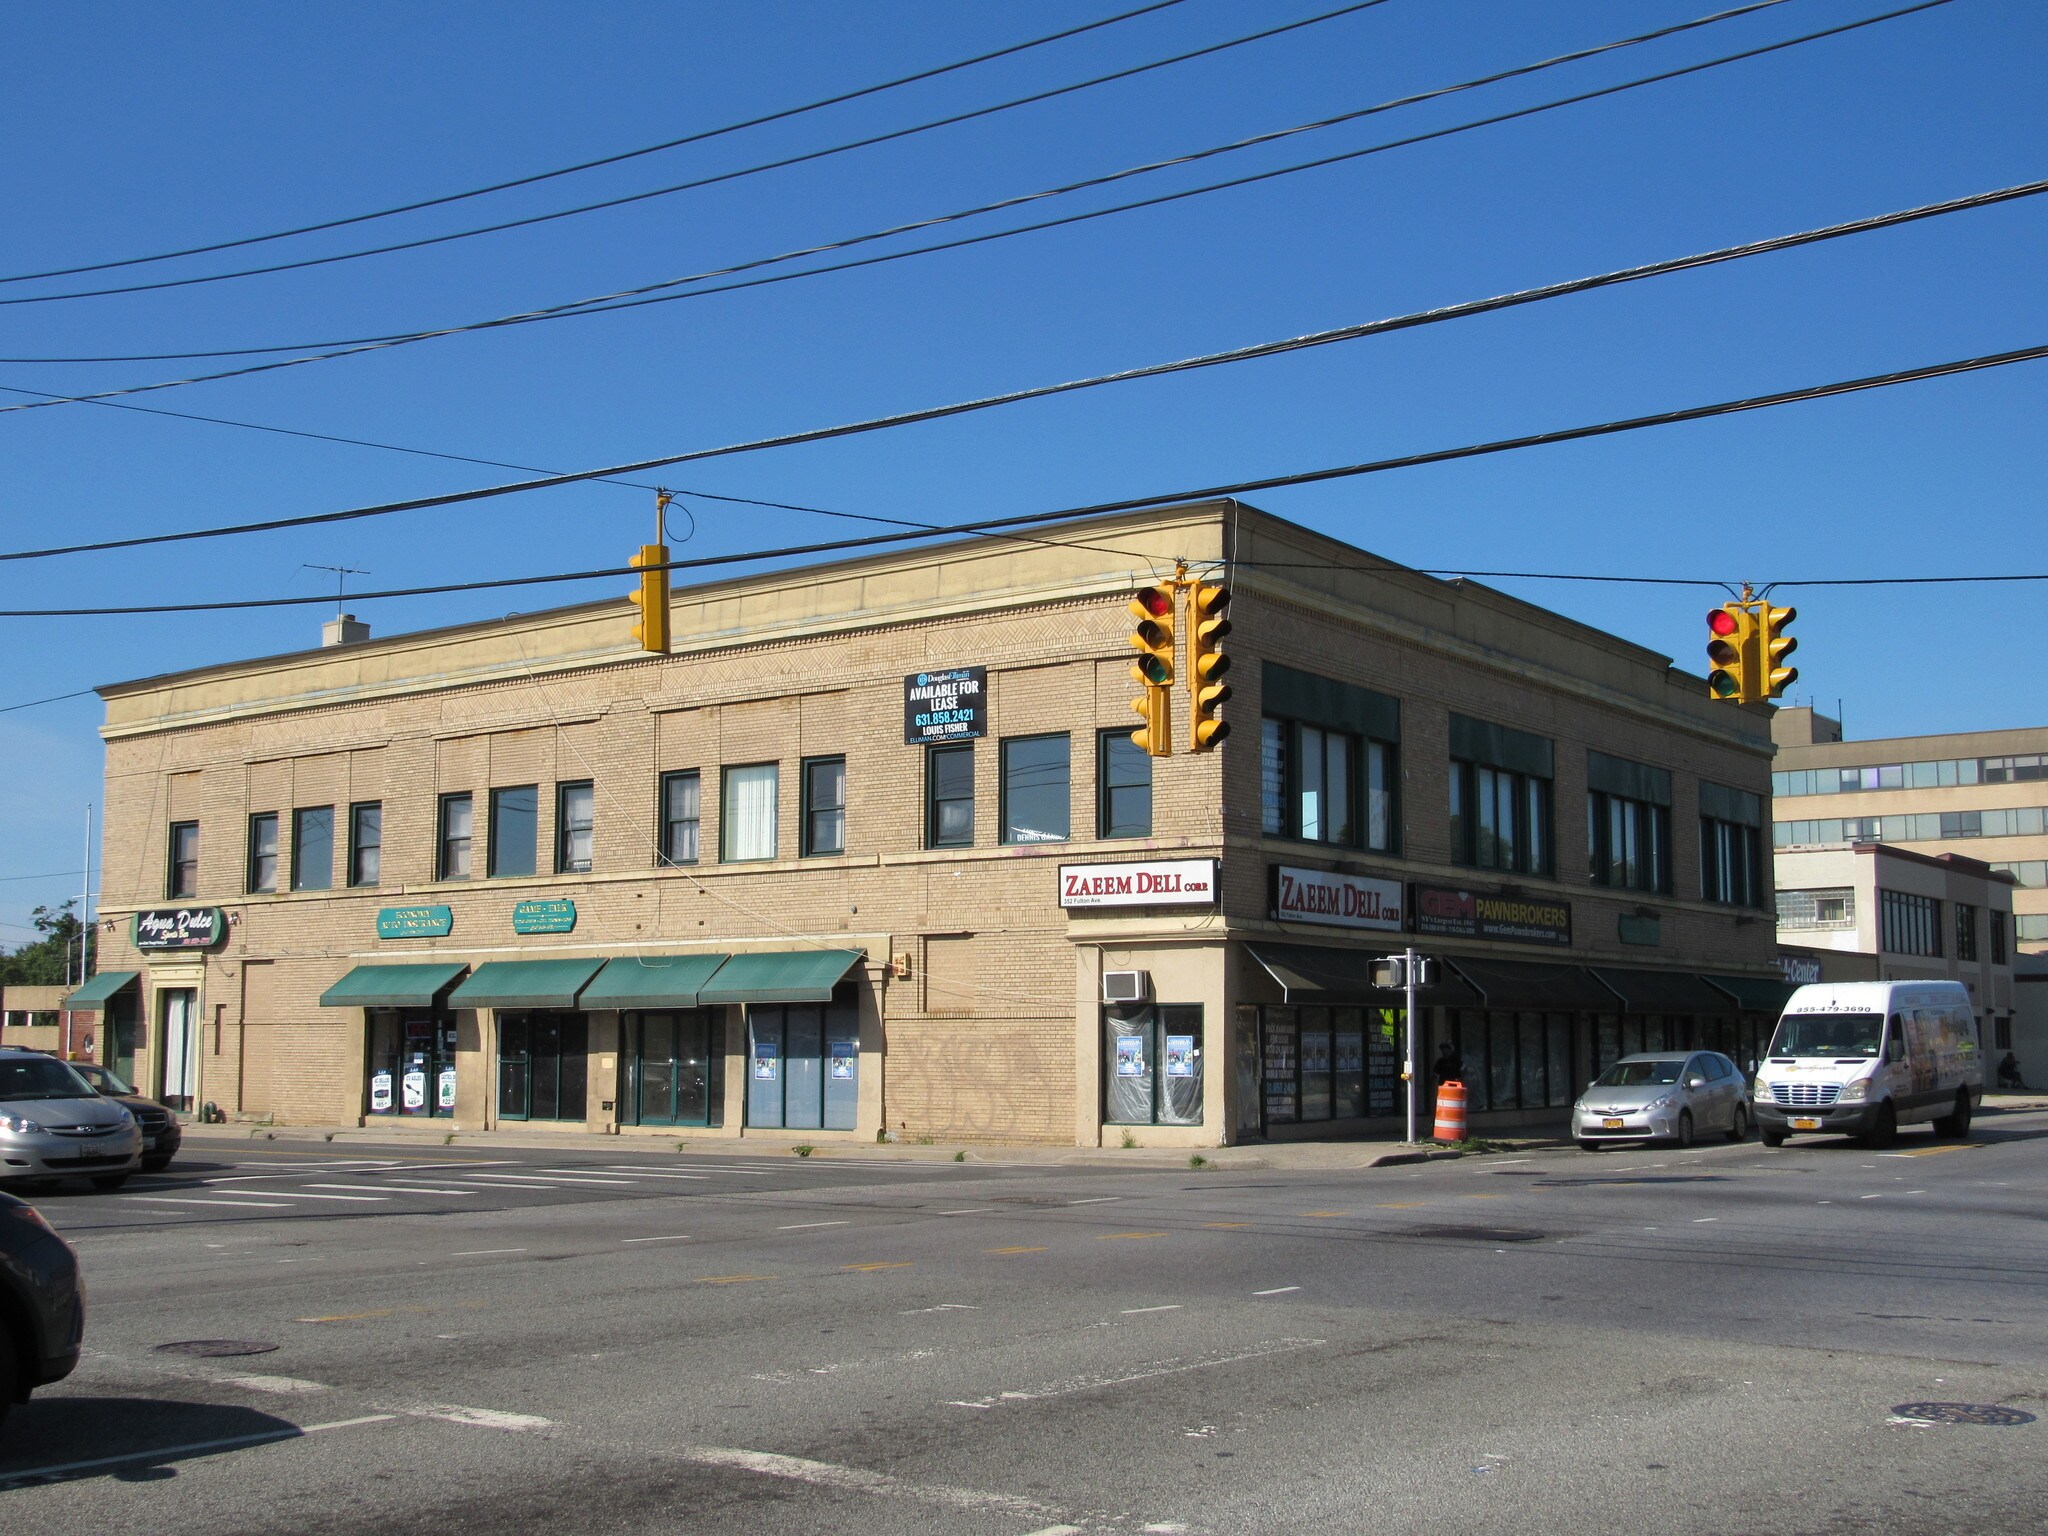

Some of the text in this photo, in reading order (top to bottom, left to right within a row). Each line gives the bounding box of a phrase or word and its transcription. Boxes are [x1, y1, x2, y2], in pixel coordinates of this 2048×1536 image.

[910, 680, 979, 701] AVAILABLE FOR
[931, 696, 958, 711] LEASE
[915, 708, 974, 726] 631.858.2421
[922, 722, 968, 736] LOUIS FISHER
[1065, 875, 1132, 896] ZAEEM
[1136, 872, 1182, 893] DELI
[1281, 874, 1340, 915] ZAEEM
[1343, 883, 1380, 919] DELI
[1420, 890, 1567, 928] GEM PAWNBROKERS
[177, 910, 213, 929] Dulce
[1483, 924, 1556, 938] www.GemPawnbrokers.com
[1790, 959, 1819, 983] Center
